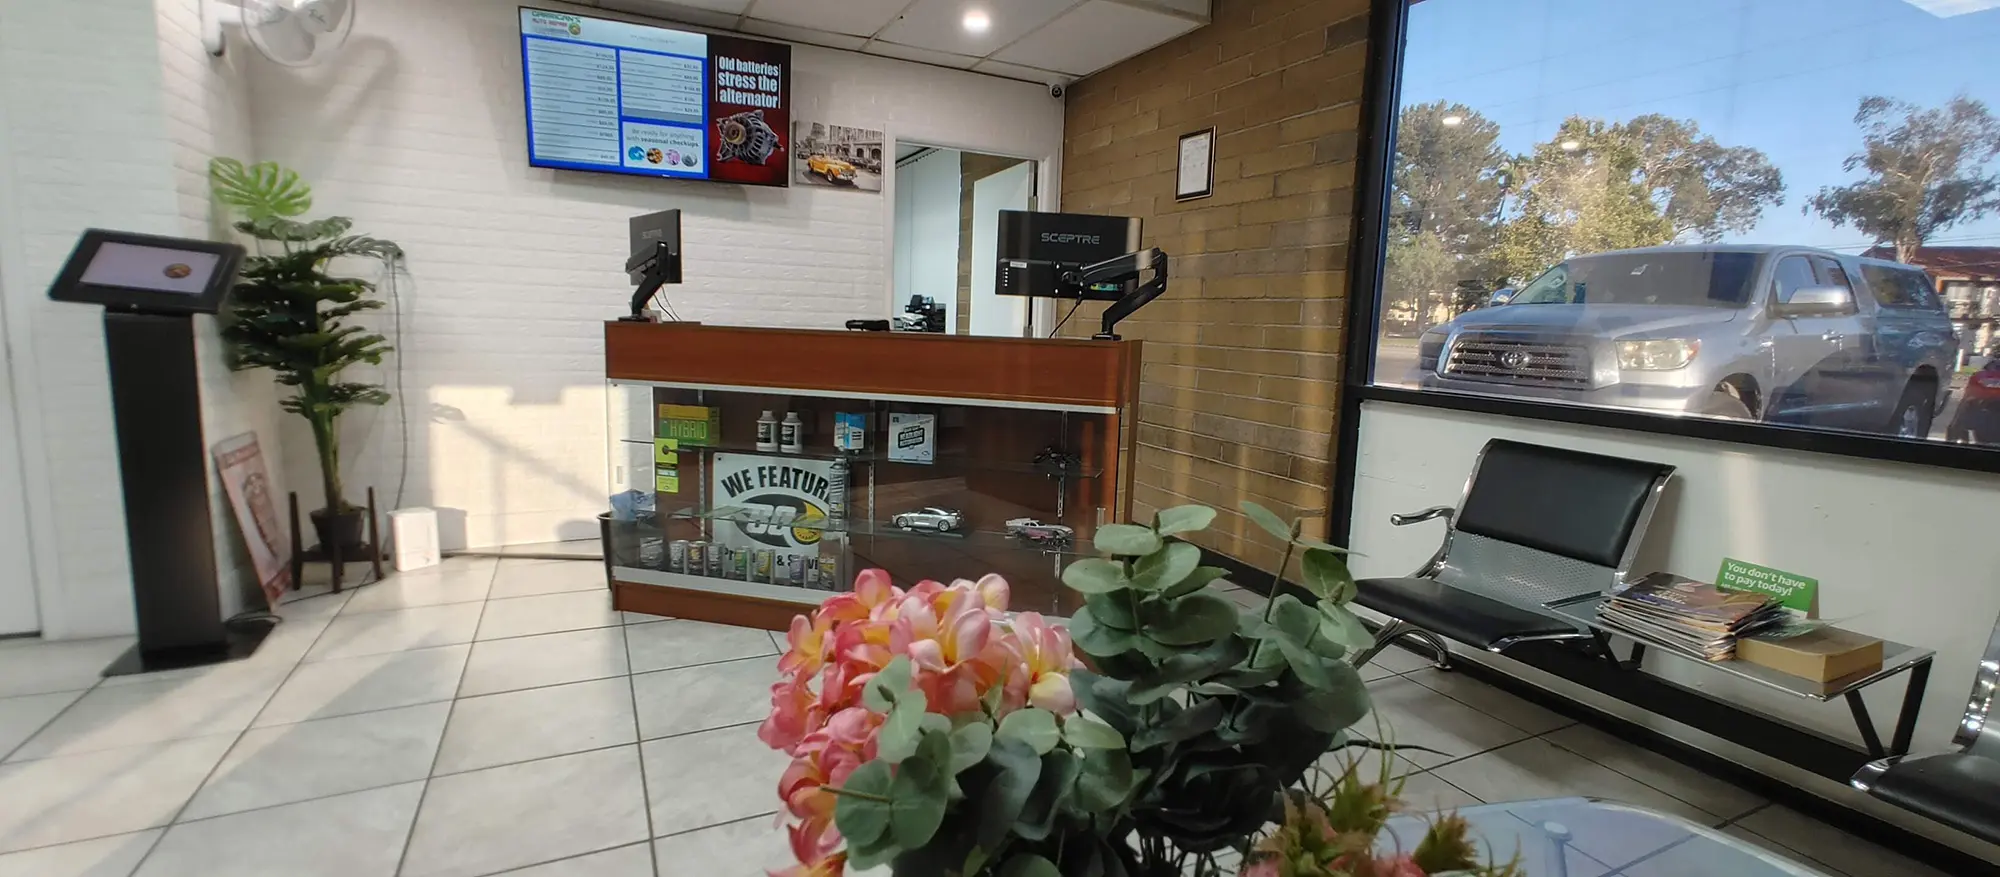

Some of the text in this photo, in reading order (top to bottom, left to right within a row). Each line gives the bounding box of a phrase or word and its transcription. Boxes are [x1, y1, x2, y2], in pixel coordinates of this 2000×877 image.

[719, 56, 735, 71] Old
[736, 58, 779, 77] batteries
[718, 71, 756, 90] stress
[757, 75, 778, 93] the
[719, 88, 778, 109] alternator
[669, 139, 699, 148] checkups
[1041, 232, 1100, 245] SCEPTRE
[721, 468, 755, 499] WE
[757, 465, 830, 502] FEATUR
[1724, 571, 1793, 597] to pay today!
[1728, 562, 1807, 590] You don't have
